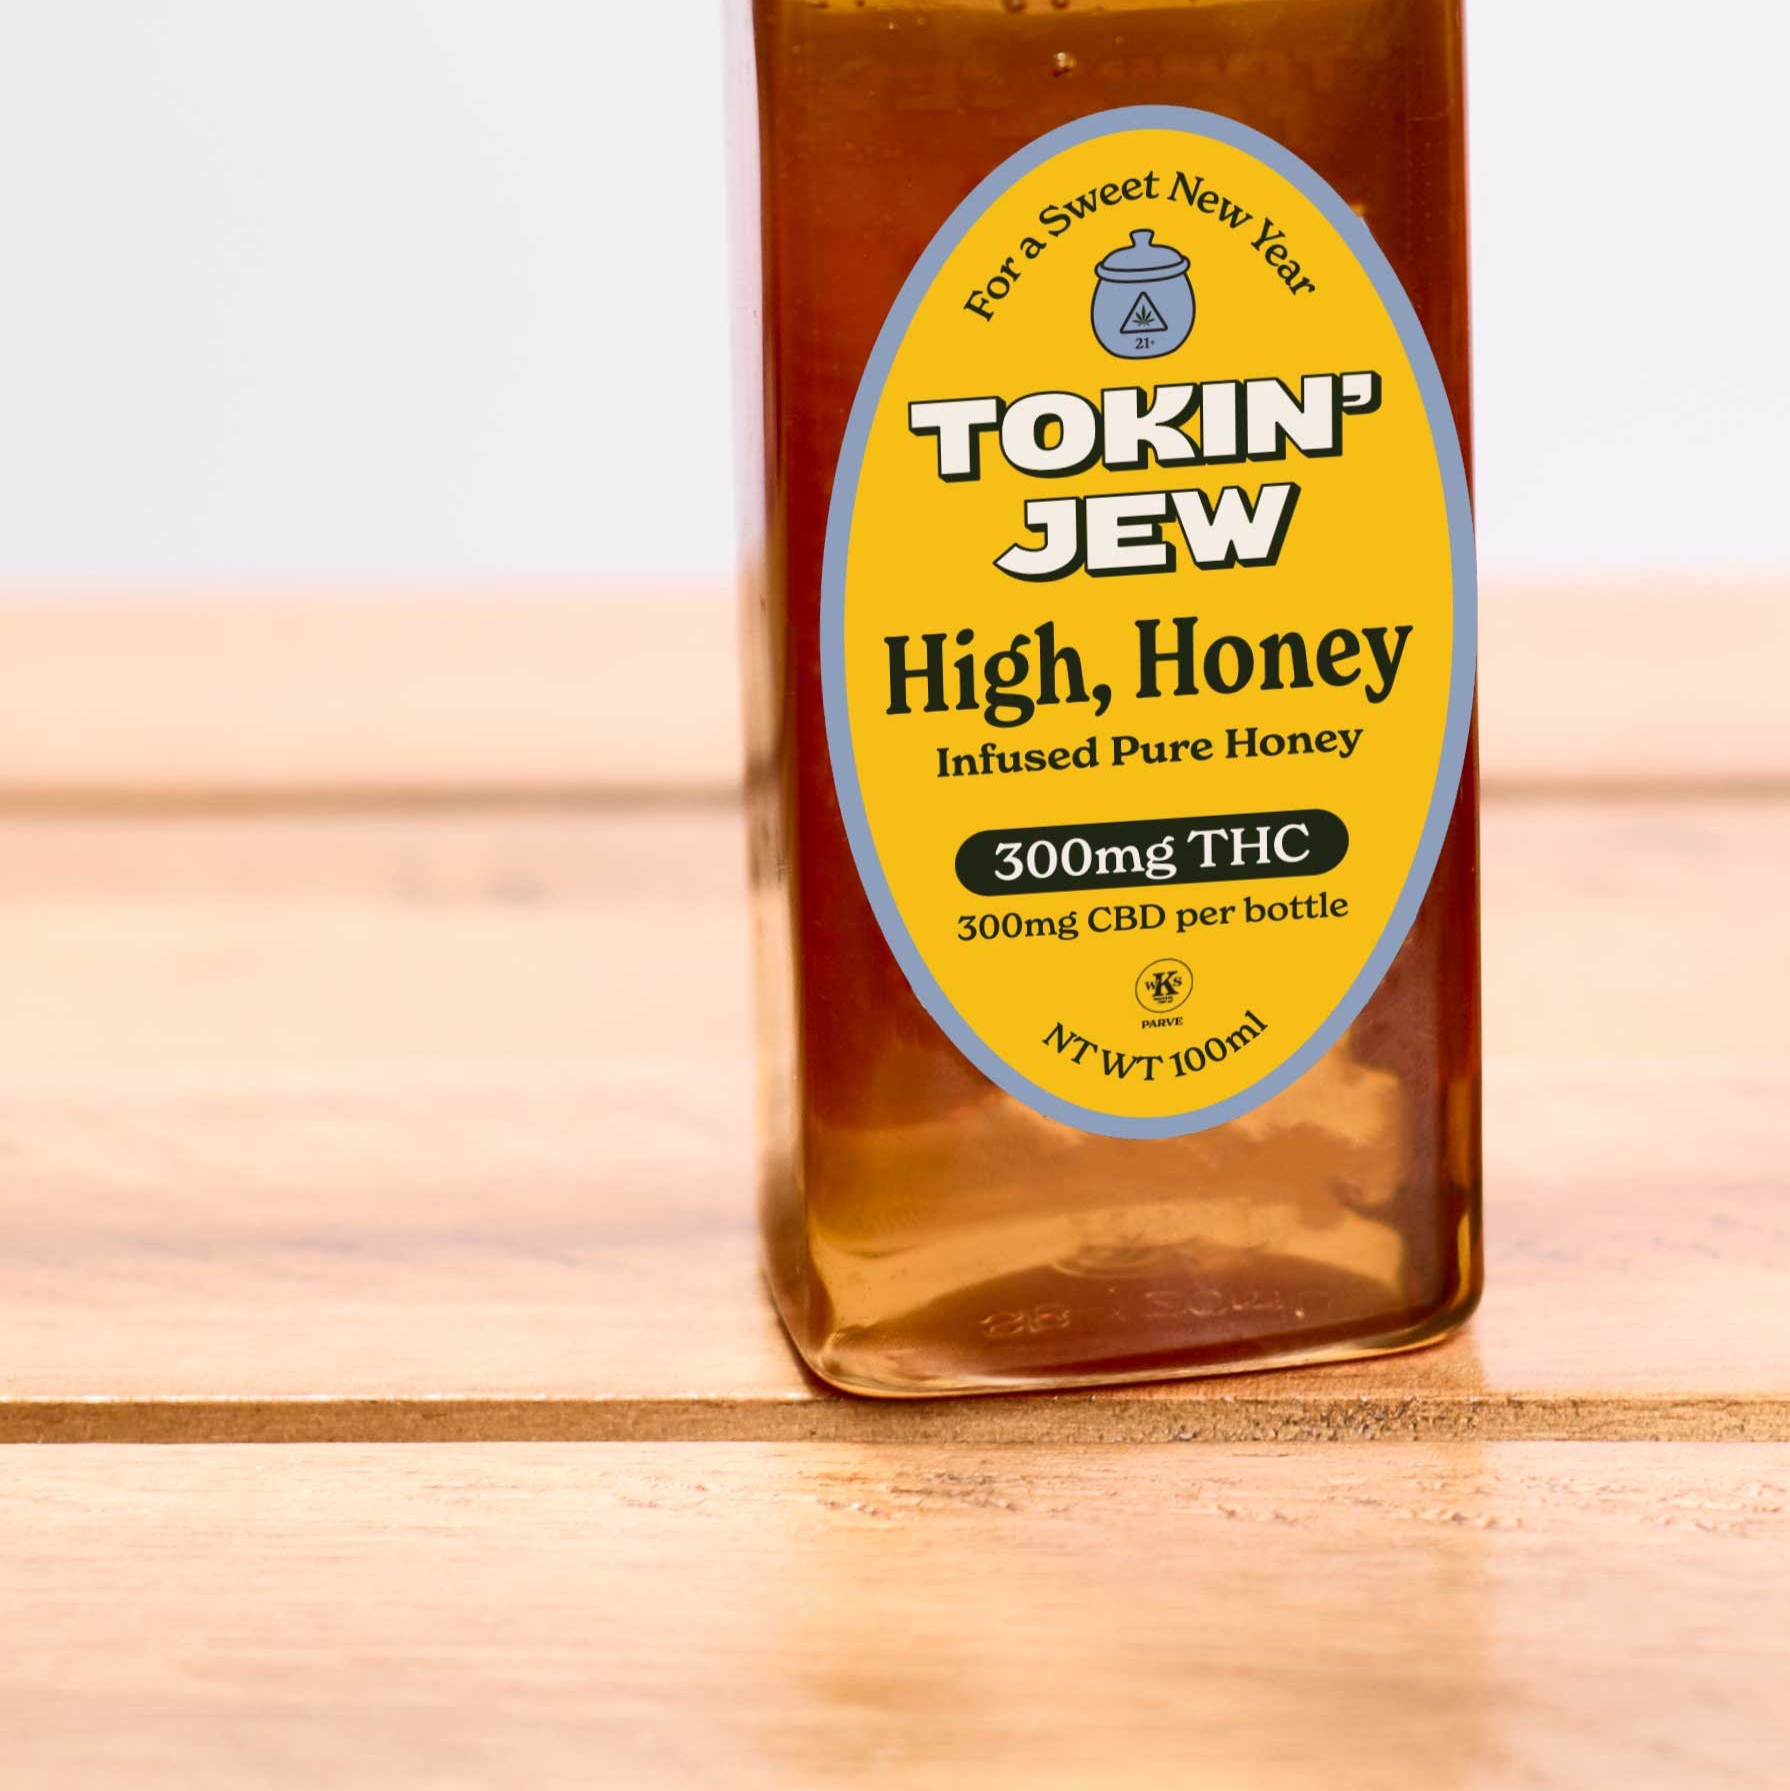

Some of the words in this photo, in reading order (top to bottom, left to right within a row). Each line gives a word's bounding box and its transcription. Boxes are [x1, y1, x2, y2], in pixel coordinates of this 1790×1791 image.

[963, 256, 1022, 322] For
[1019, 237, 1047, 260] a
[1038, 170, 1161, 238] Sweet
[1167, 171, 1254, 229] New
[1250, 217, 1316, 298] Year
[993, 481, 1302, 583] JEW
[883, 620, 1112, 729] High,
[1134, 616, 1414, 705] Honey
[936, 735, 1100, 778] Infused
[1111, 735, 1214, 768] Pure
[1225, 727, 1364, 759] Honey
[993, 835, 1178, 881] 300mg
[1186, 822, 1311, 869] THC
[956, 910, 1080, 942] 300mg
[1087, 903, 1166, 933] CBD
[1175, 905, 1236, 934] per
[1243, 891, 1349, 923] bottle
[1041, 1021, 1099, 1065] NT
[1101, 1049, 1164, 1082] WT
[1168, 1010, 1269, 1079] 100ml
[1141, 1016, 1184, 1029] PARVE
